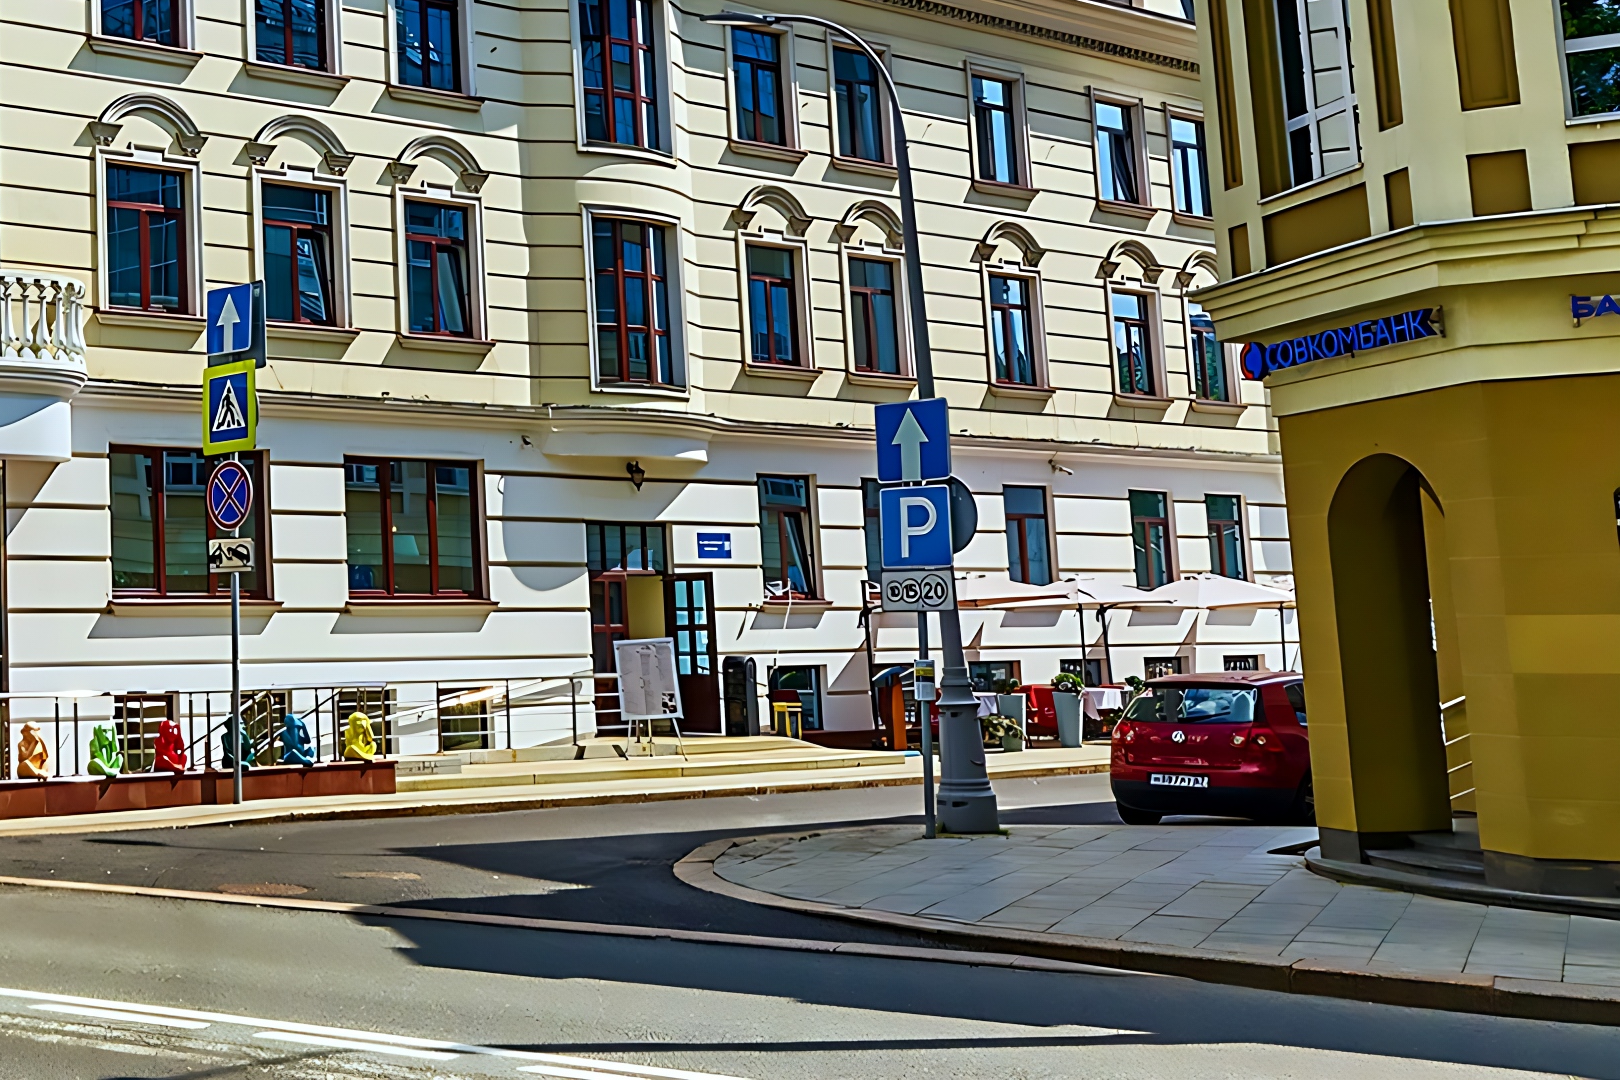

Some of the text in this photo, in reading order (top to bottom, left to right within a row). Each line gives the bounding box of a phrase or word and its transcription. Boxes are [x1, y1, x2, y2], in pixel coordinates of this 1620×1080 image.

[1265, 308, 1429, 371] СОВКОМБАНК
[900, 496, 937, 558] P
[923, 581, 946, 600] 20
